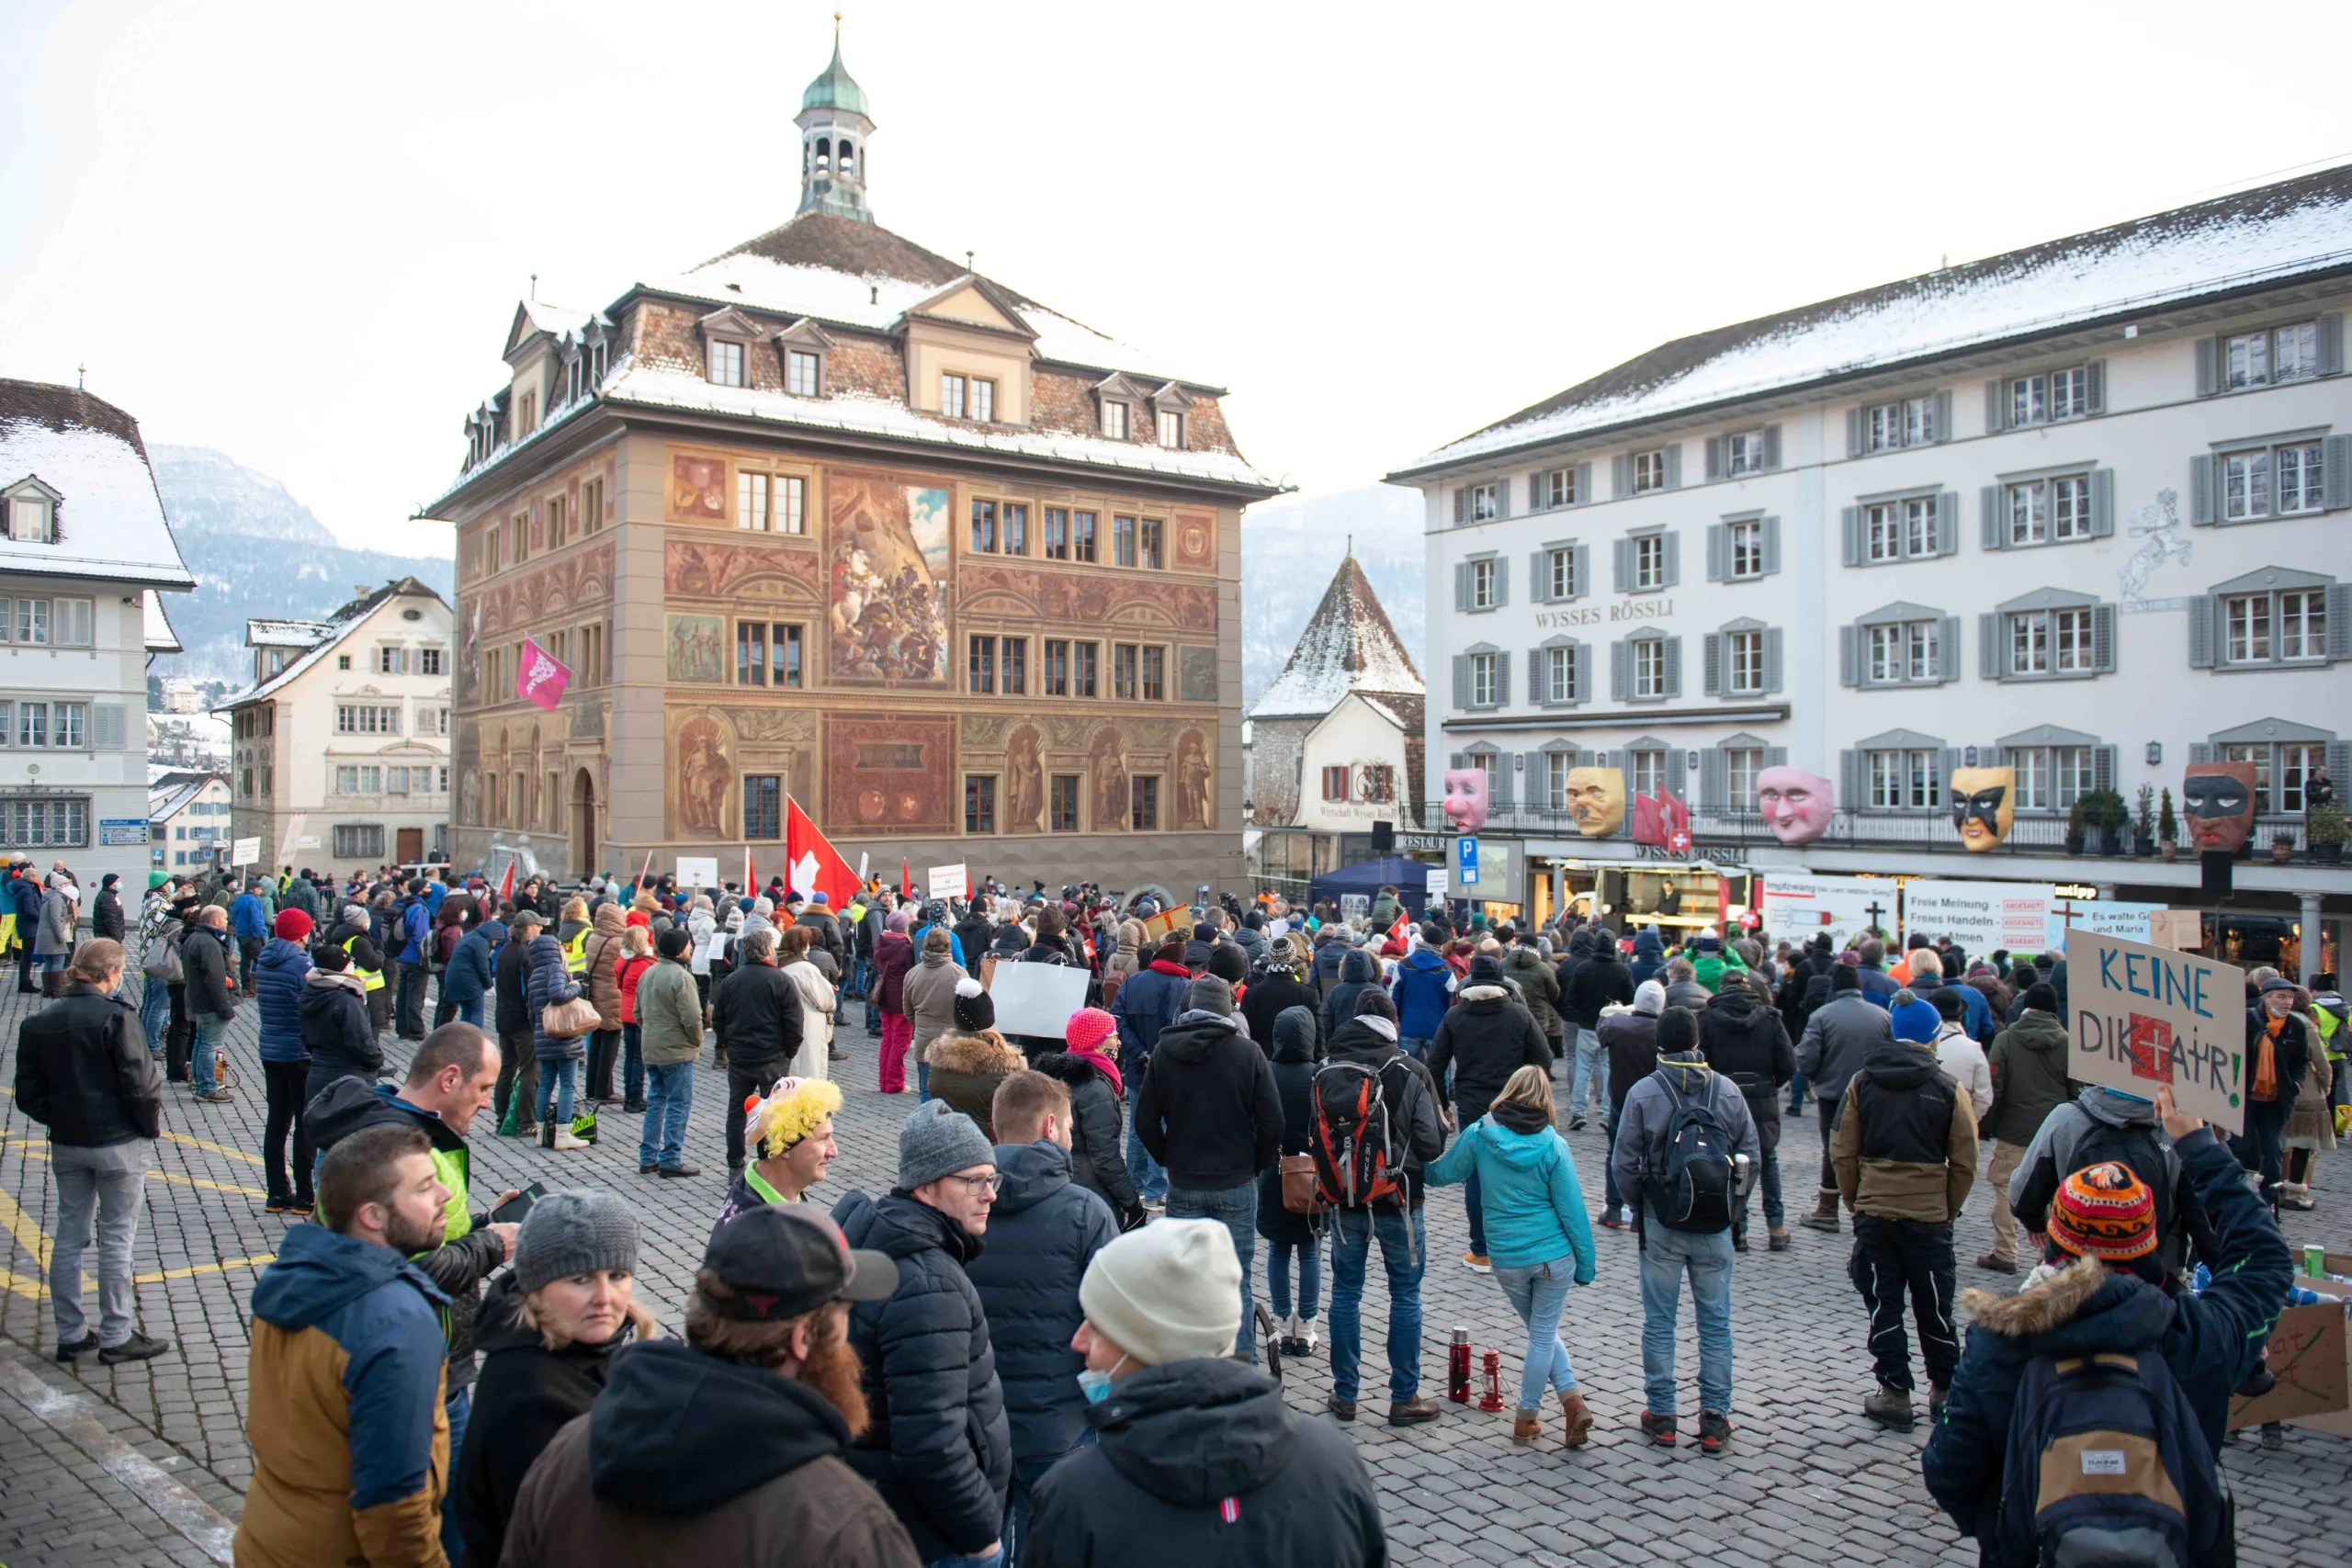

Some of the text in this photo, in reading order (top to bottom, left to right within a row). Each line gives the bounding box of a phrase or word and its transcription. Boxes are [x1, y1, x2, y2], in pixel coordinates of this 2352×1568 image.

[1535, 599, 1673, 629] WYSSES RÖSSLI
[1401, 835, 1445, 849] RESTAUR
[1463, 840, 1472, 858] P
[1766, 882, 1816, 894] Impfzwang
[2054, 884, 2097, 899] mtipp
[1911, 897, 1938, 907] Freie
[1940, 898, 1989, 911] Meinung
[1910, 913, 1943, 924] Freies
[1947, 914, 1994, 926] Handeln
[2092, 911, 2150, 920] Es walte Go
[1949, 931, 1983, 942] Atmen
[2093, 925, 2143, 934] und Maria
[2099, 948, 2213, 1019] KEINE
